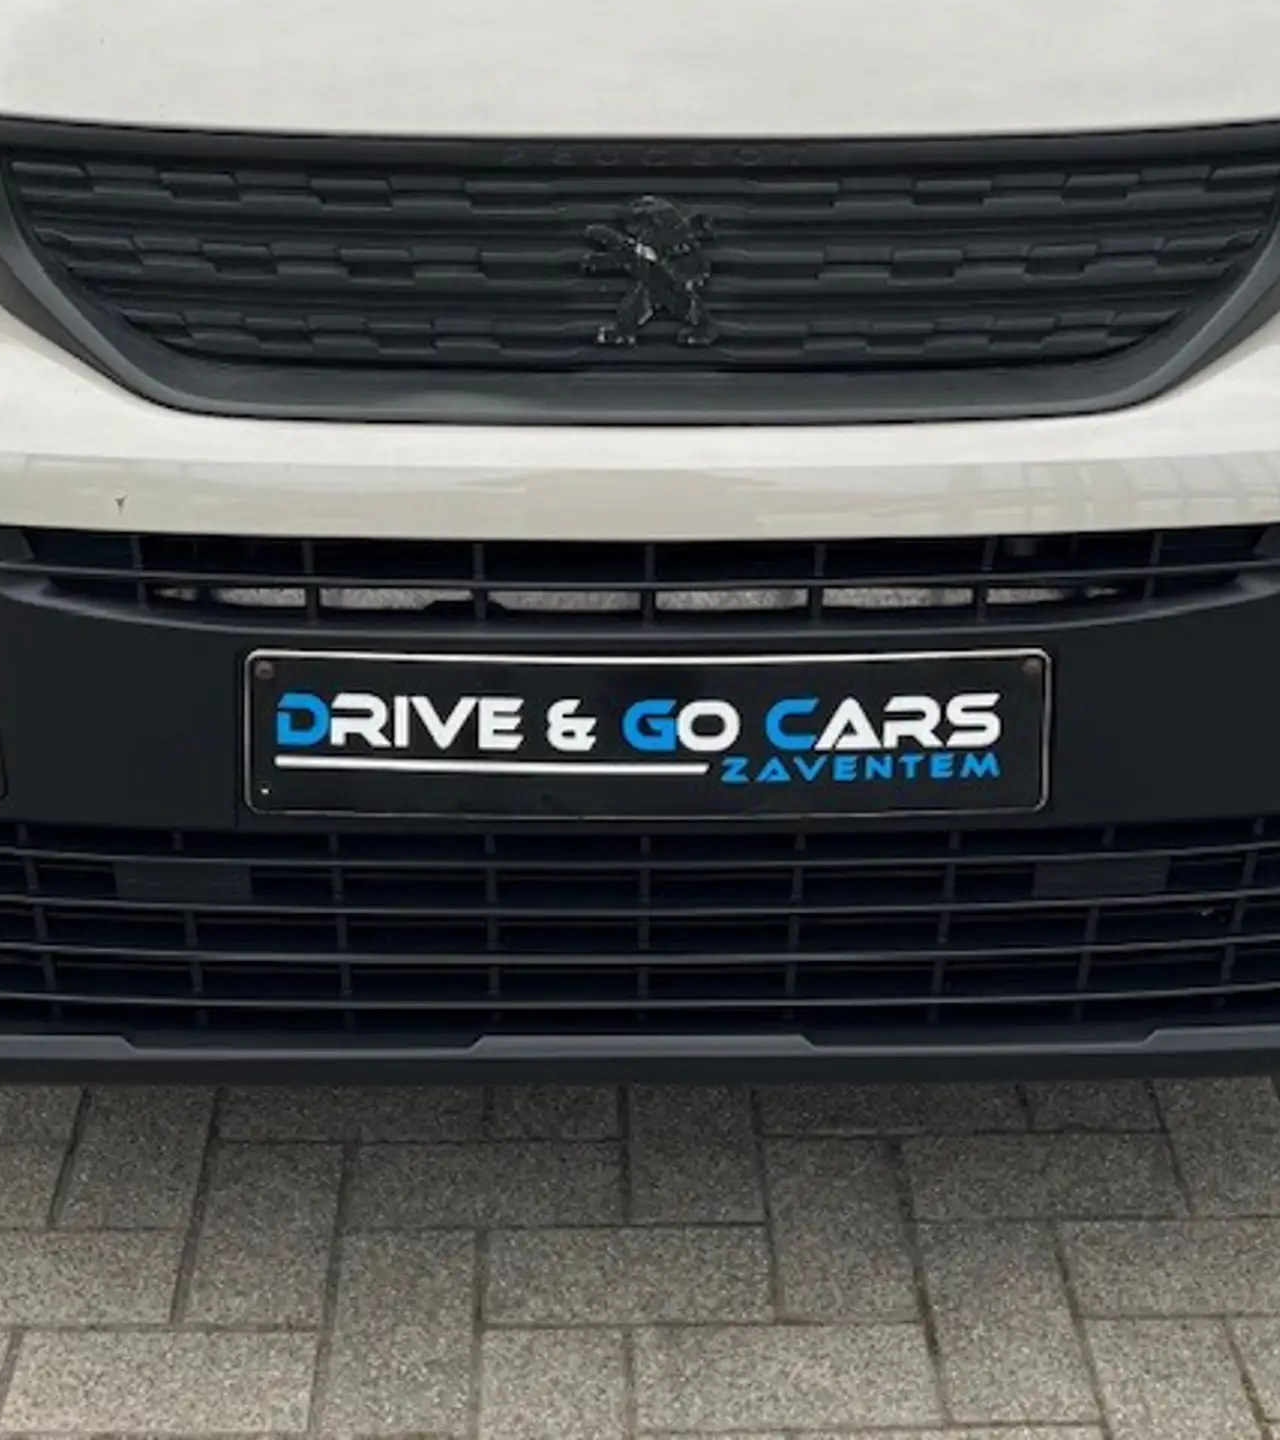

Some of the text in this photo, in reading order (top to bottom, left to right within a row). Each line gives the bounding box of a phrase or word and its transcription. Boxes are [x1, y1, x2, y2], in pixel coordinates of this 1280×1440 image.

[501, 144, 806, 167] PEUGEOT
[276, 692, 1001, 751] DRIVE & GO CARS
[721, 753, 1001, 782] ZAVENTEM
